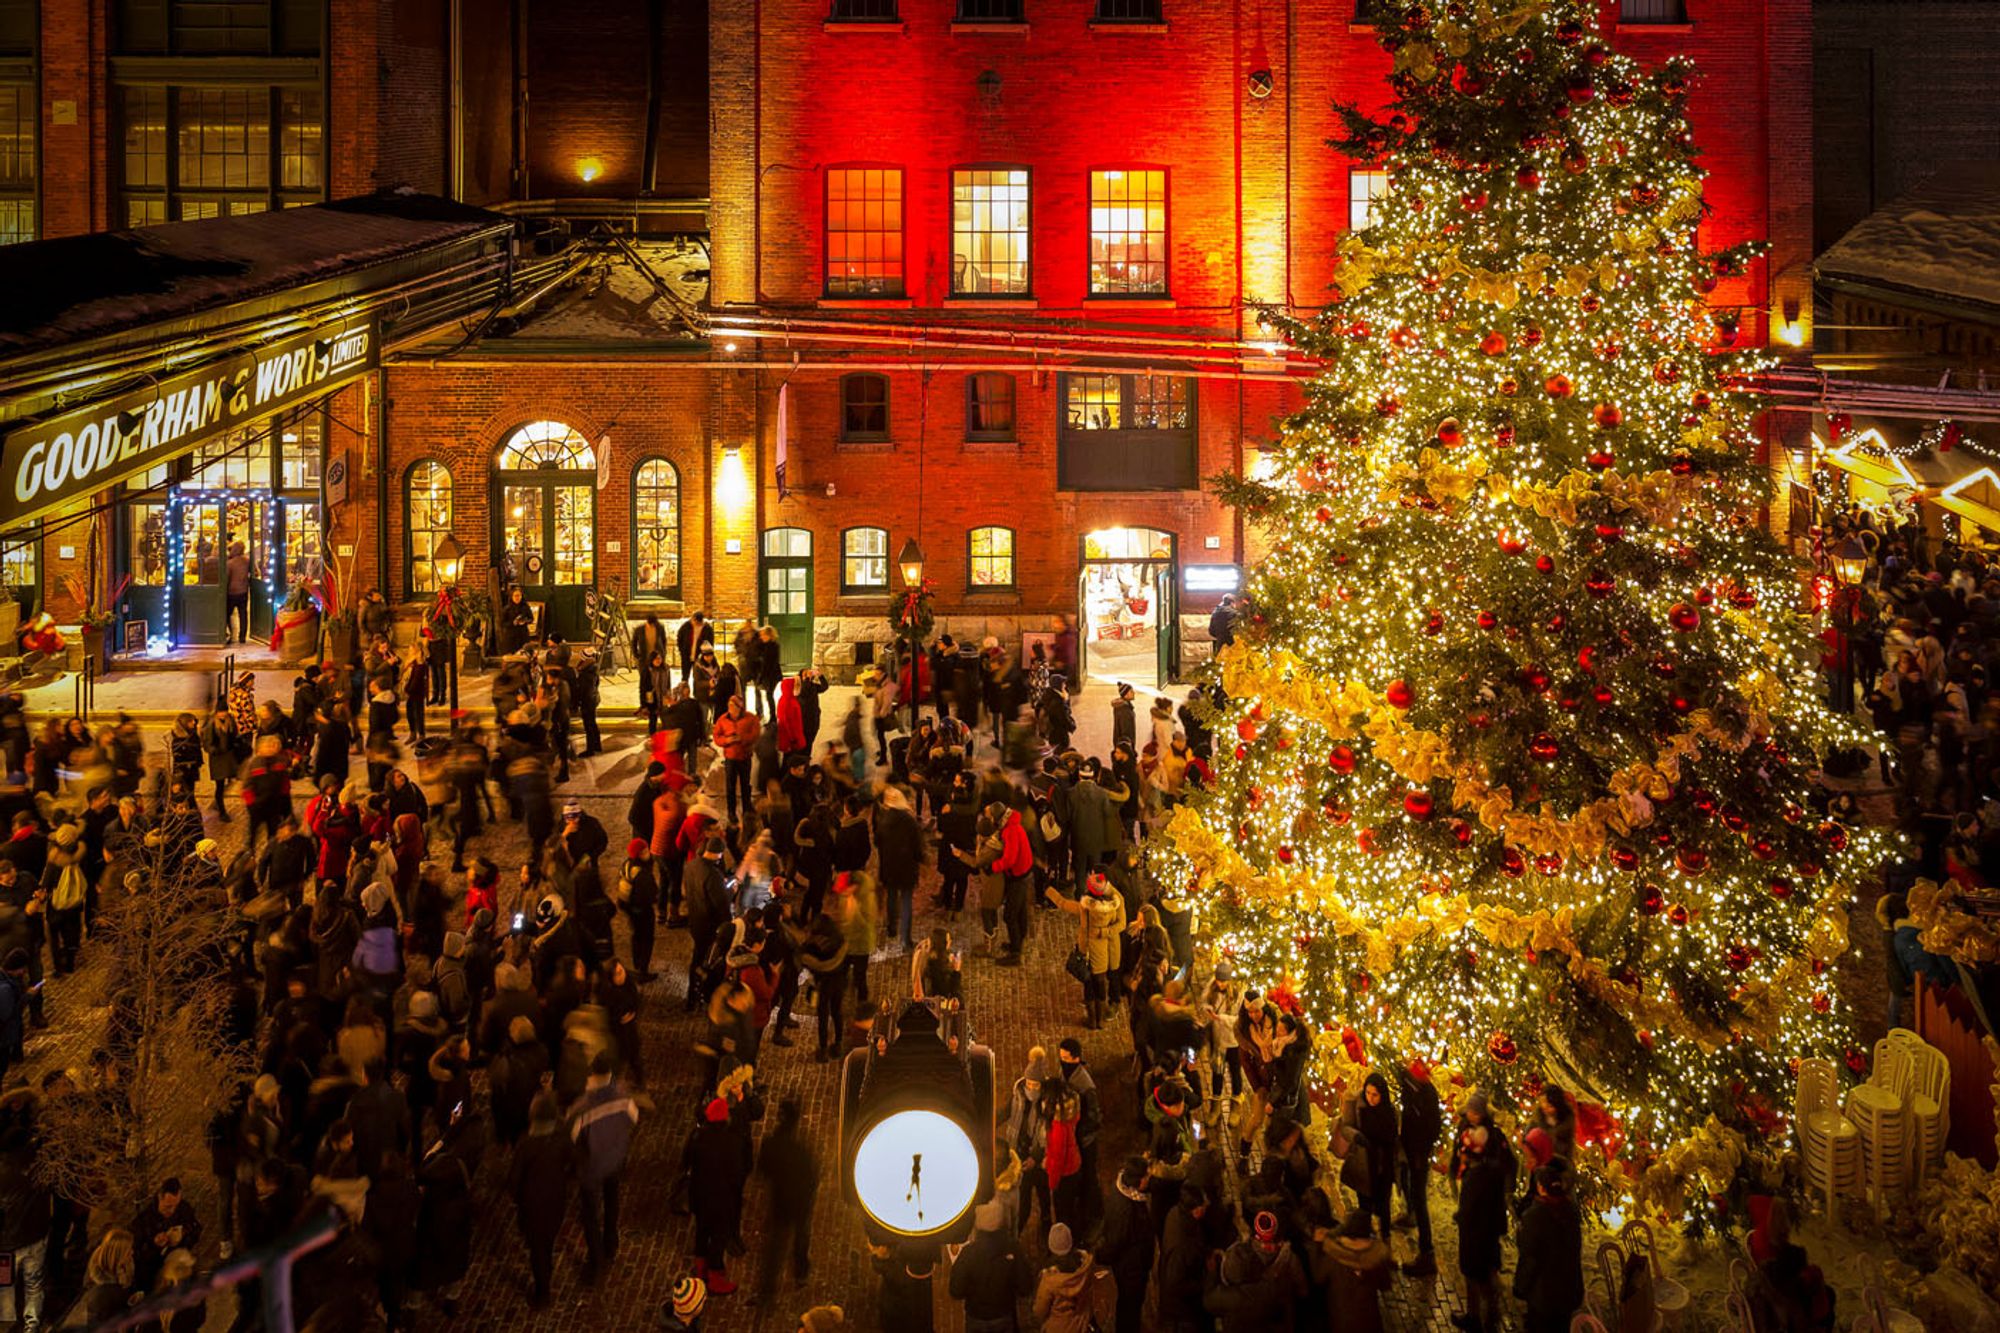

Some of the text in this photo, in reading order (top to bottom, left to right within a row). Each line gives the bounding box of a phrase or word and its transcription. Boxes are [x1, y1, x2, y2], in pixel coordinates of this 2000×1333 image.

[15, 376, 227, 503] GOODERHAM
[255, 338, 332, 406] WORTS
[330, 333, 369, 367] LIMITED
